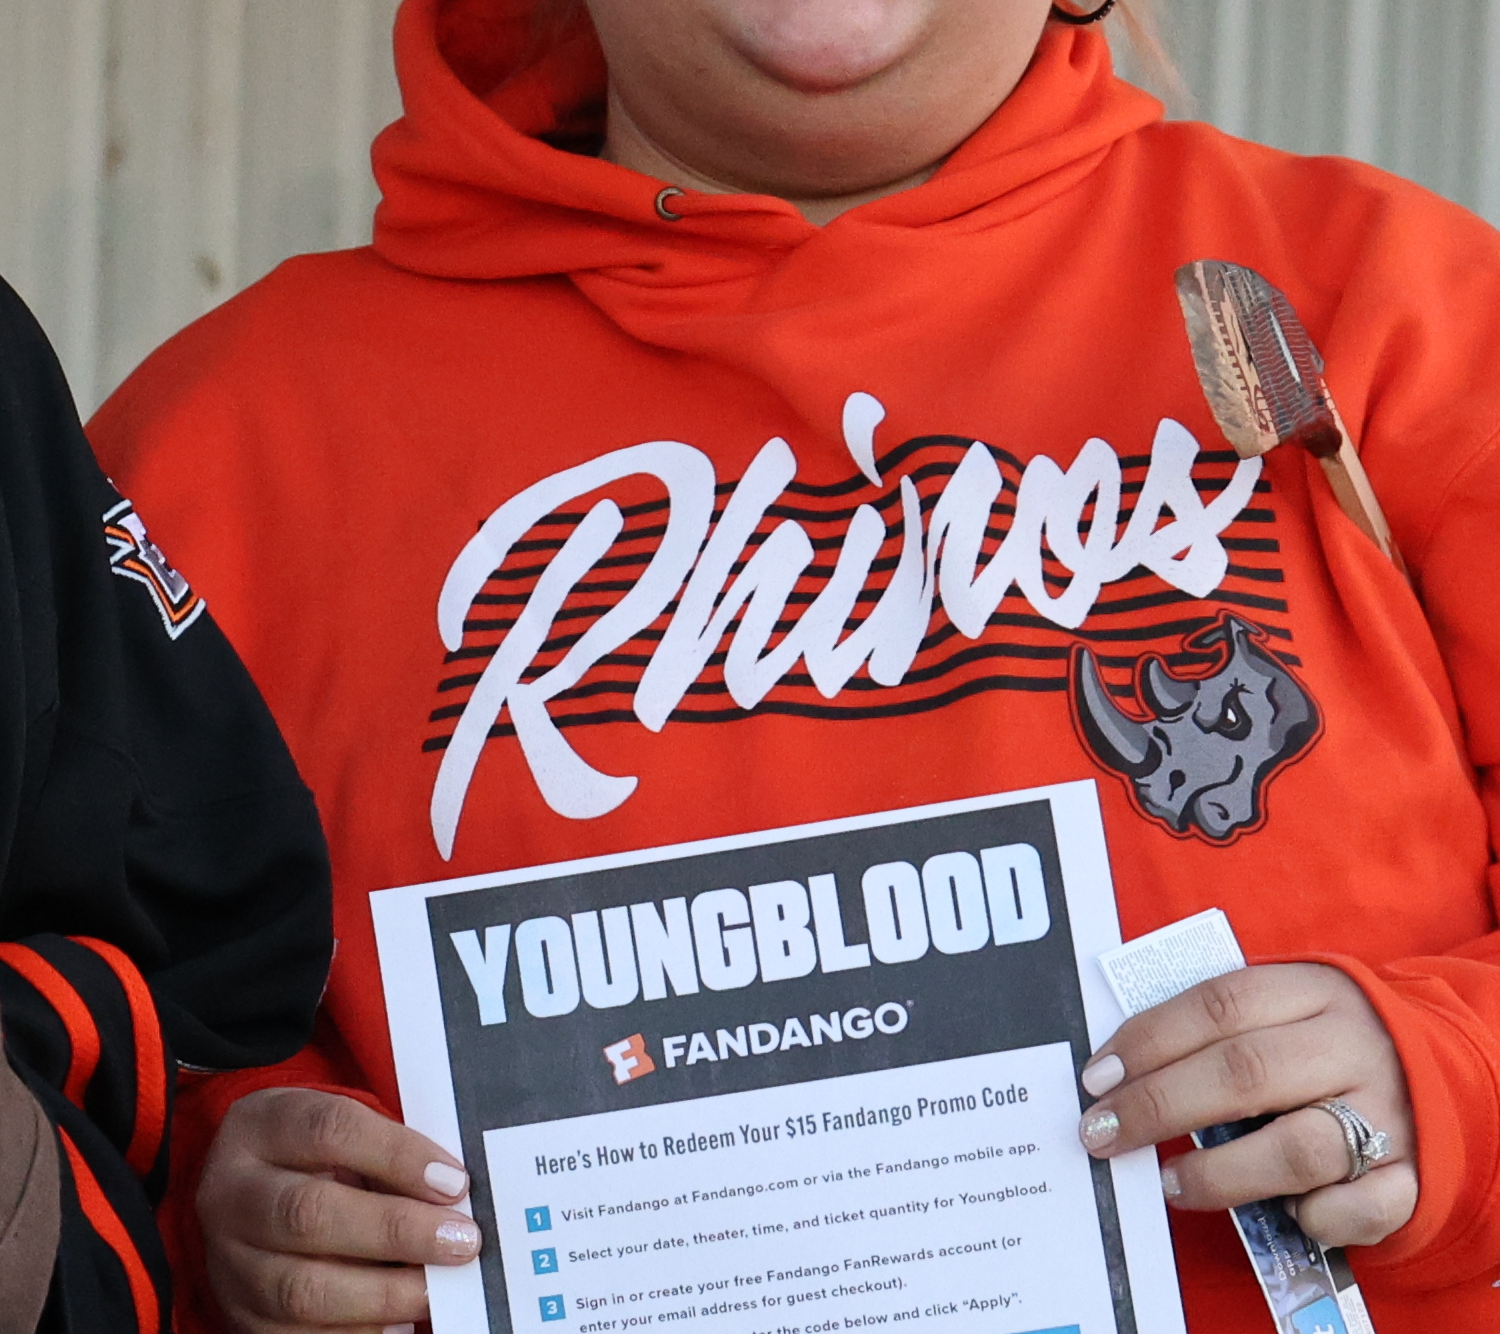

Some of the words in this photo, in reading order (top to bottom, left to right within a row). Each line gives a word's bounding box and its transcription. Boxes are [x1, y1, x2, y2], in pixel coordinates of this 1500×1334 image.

[429, 390, 1266, 862] Rhinos
[448, 841, 1051, 1026] YOUNGBLOOD
[661, 1000, 908, 1069] FANDANGO
[533, 1148, 593, 1176] Here's
[594, 1144, 635, 1167] How
[637, 1140, 658, 1160] to
[661, 1130, 736, 1157] Redeem
[737, 1122, 781, 1145] Your
[783, 1113, 818, 1139] $15
[820, 1103, 913, 1133] Fandango
[915, 1093, 977, 1118] Promo
[980, 1082, 1029, 1109] Code
[532, 1211, 542, 1226] 1
[559, 1205, 595, 1222] Visit
[596, 1197, 670, 1218] Fandango
[672, 1192, 689, 1206] at
[690, 1177, 799, 1203] Fandango.com
[802, 1174, 818, 1186] or
[820, 1169, 844, 1183] via
[846, 1165, 872, 1180] the
[874, 1155, 950, 1175] Fandango
[952, 1145, 1004, 1164] mobile
[1007, 1142, 1041, 1157] app.
[537, 1252, 551, 1268] 2
[566, 1245, 613, 1263] Select
[615, 1242, 649, 1259] your
[651, 1236, 690, 1251] date,
[691, 1227, 749, 1245] theater,
[750, 1222, 789, 1236] time,
[791, 1214, 820, 1230] and
[822, 1208, 865, 1226] ticket
[868, 1199, 930, 1221] quantity
[932, 1196, 955, 1210] for
[957, 1179, 1052, 1205] Youngblood.
[546, 1299, 558, 1315] 3
[574, 1296, 608, 1311] Sign
[610, 1291, 625, 1305] in
[627, 1290, 644, 1303] or
[646, 1283, 693, 1300] create
[695, 1278, 730, 1296] your
[732, 1273, 763, 1287] free
[765, 1262, 840, 1283] Fandango
[842, 1247, 935, 1271] FanRewards
[937, 1237, 998, 1257] account
[1000, 1235, 1022, 1251] (or
[578, 1318, 617, 1334] enter
[619, 1313, 653, 1331] your
[656, 1304, 697, 1323] email
[699, 1298, 758, 1317] address
[760, 1294, 782, 1308] for
[785, 1286, 828, 1307] guest
[829, 1276, 907, 1298] checkout).
[803, 1318, 840, 1334] code
[842, 1312, 889, 1329] below
[891, 1305, 921, 1322] and
[923, 1300, 959, 1317] click
[961, 1291, 1023, 1312] "Apply".
